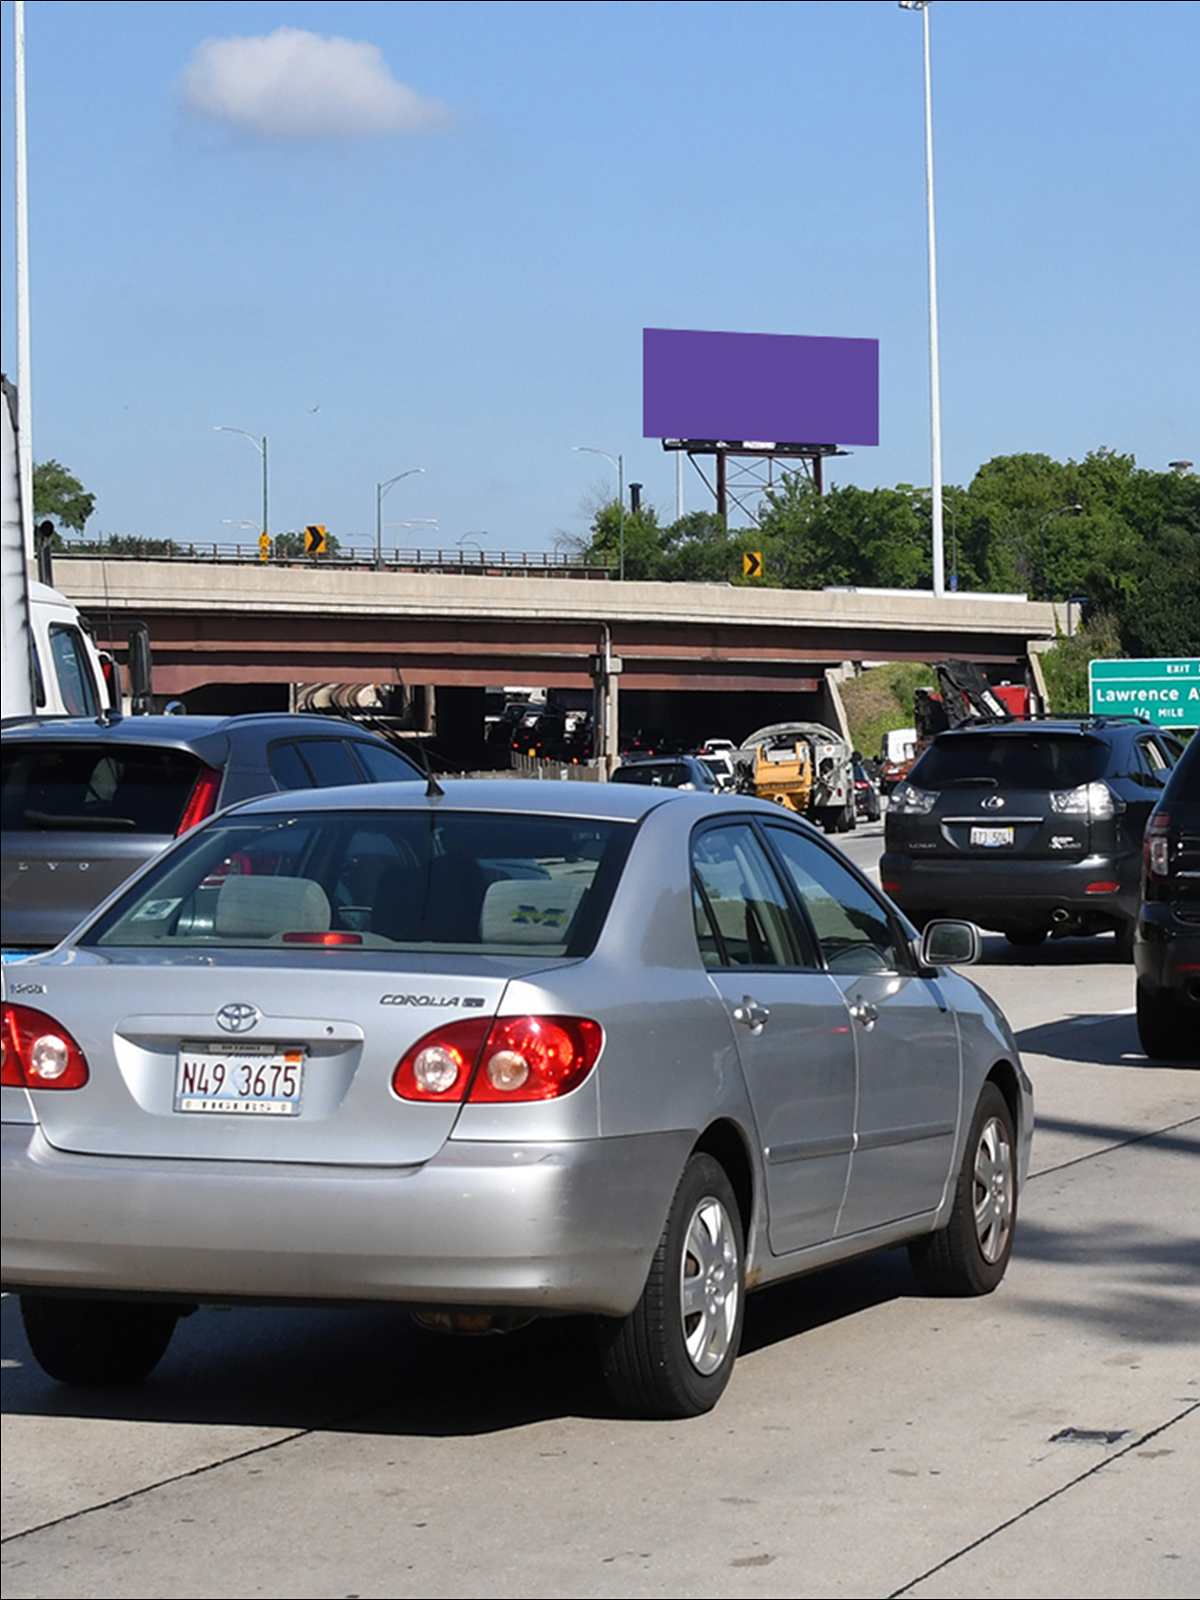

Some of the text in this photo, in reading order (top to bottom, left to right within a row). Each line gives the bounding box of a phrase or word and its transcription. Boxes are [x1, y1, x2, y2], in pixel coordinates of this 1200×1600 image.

[1166, 664, 1191, 674] EXIT
[1096, 688, 1180, 702] Lawrence
[1157, 708, 1184, 718] MILE
[379, 994, 460, 1007] COROLLA
[181, 1062, 298, 1098] N49 3675
